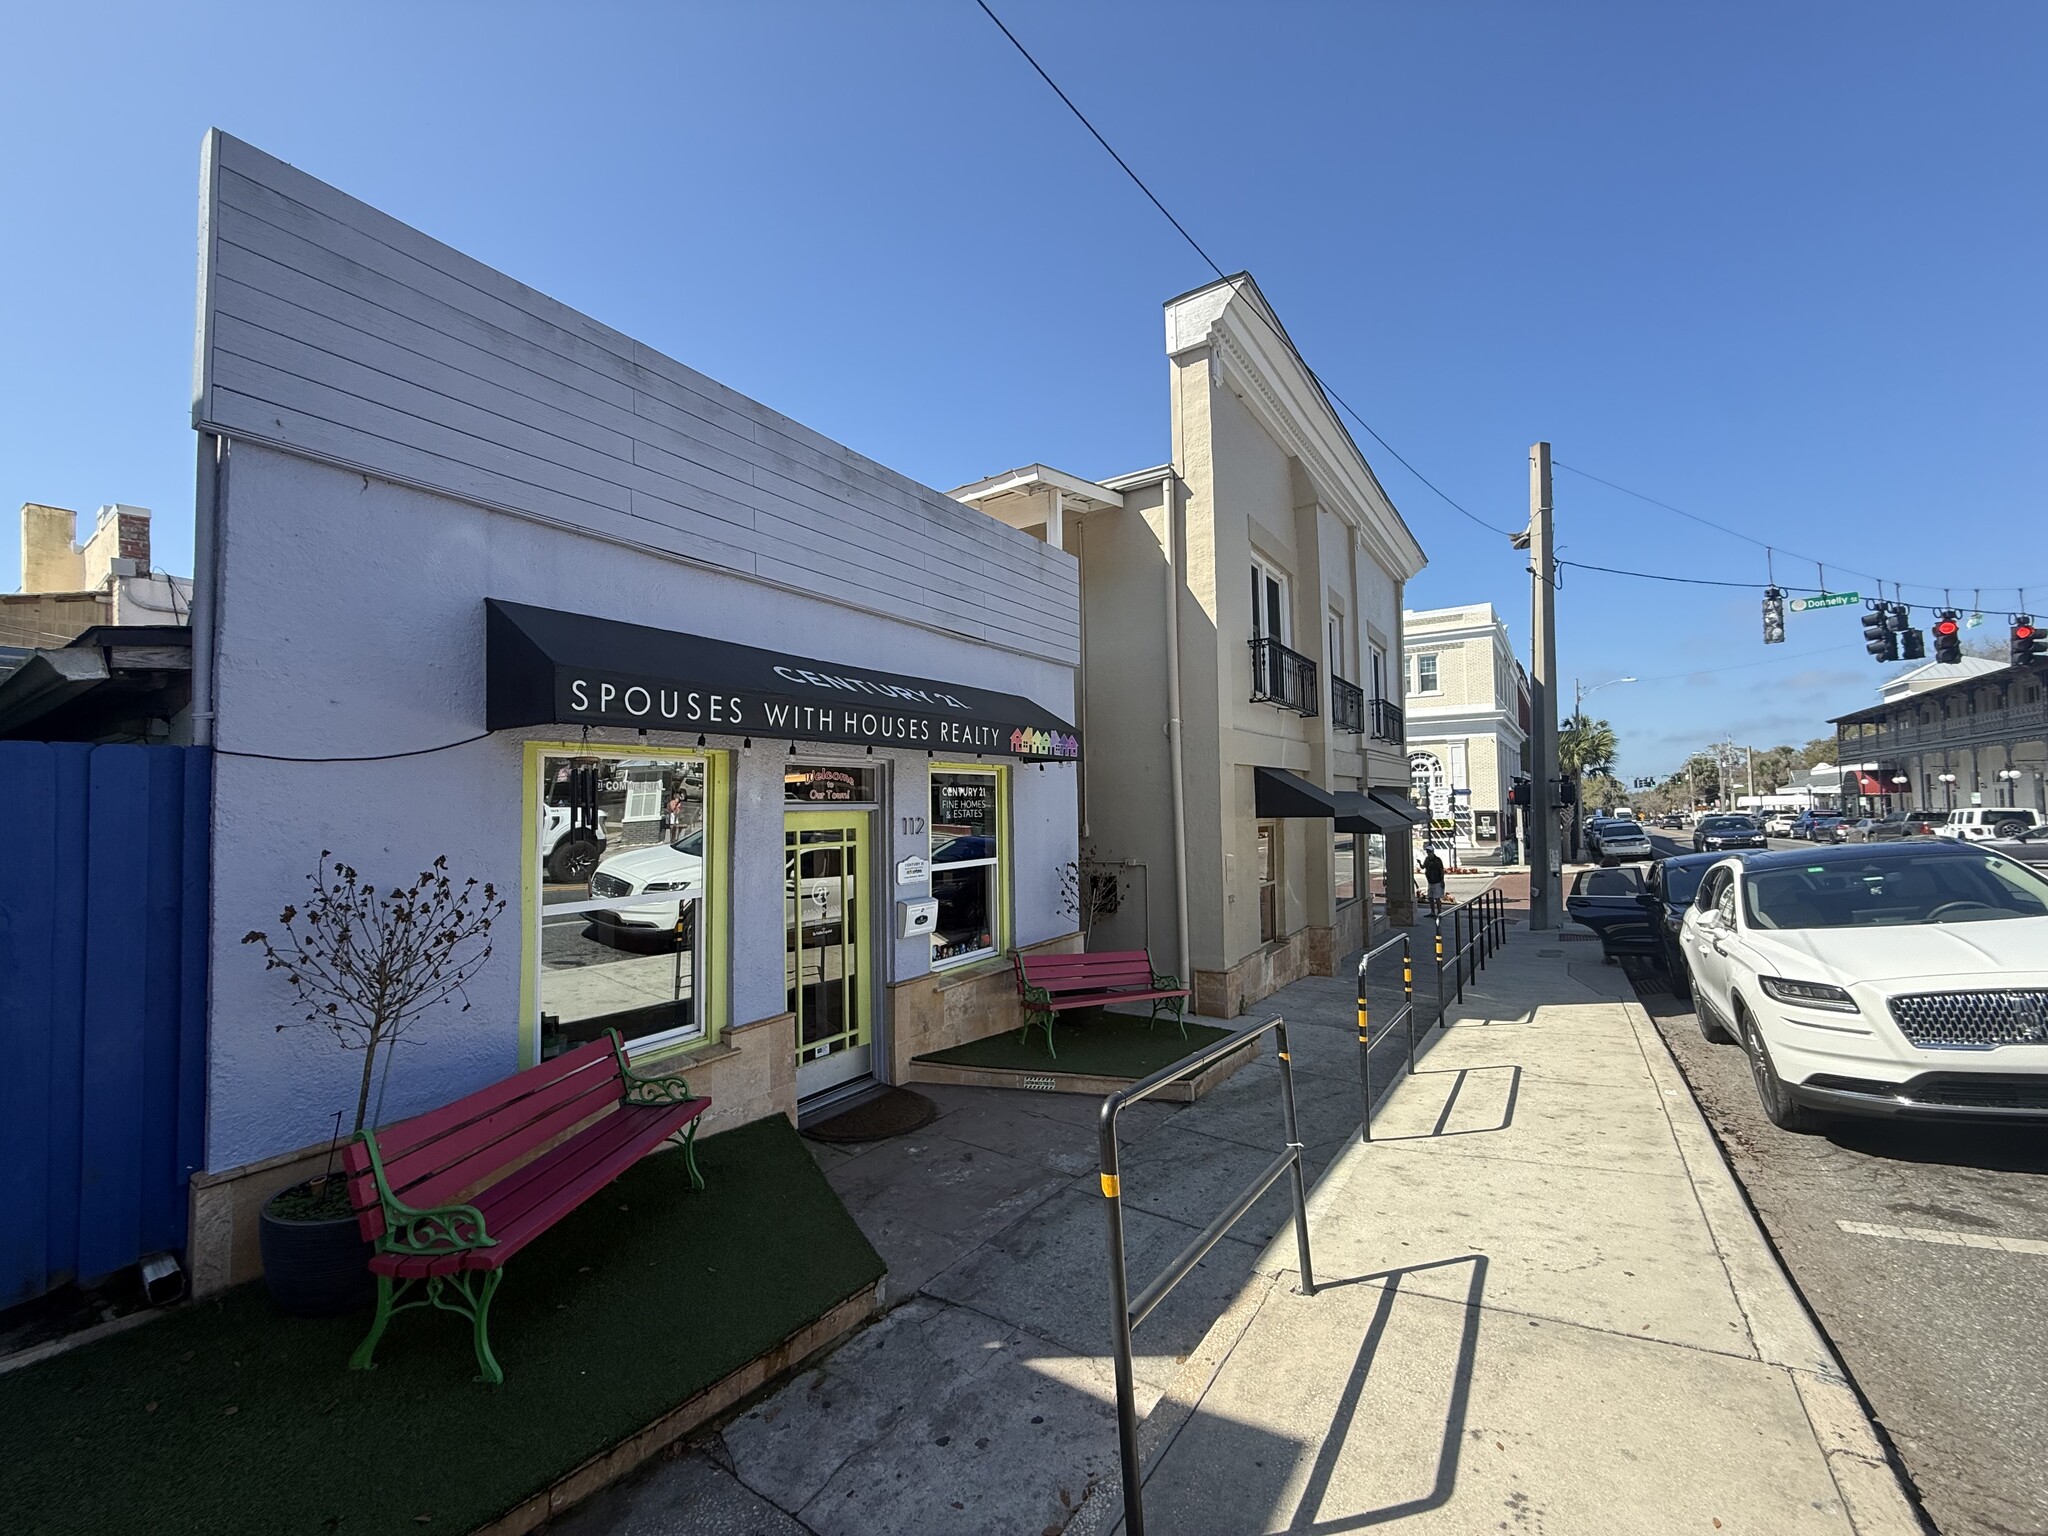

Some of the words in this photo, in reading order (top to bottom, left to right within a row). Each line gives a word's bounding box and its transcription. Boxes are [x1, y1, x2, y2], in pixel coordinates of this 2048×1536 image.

[1808, 596, 1848, 608] Donnelly
[773, 666, 934, 704] CENTURY
[571, 679, 742, 724] SPOUSES
[764, 702, 833, 732] WITH
[844, 711, 929, 741] HOUSES
[940, 721, 1000, 747] REALTY
[805, 767, 854, 786] Welcome
[826, 780, 835, 789] to
[809, 789, 825, 800] Our
[941, 786, 978, 797] CENTURY
[978, 786, 986, 797] 21
[942, 800, 959, 809] FINE
[960, 799, 987, 809] HOMES
[946, 810, 951, 819] &
[953, 809, 983, 819] ESTATES
[902, 816, 925, 835] 112
